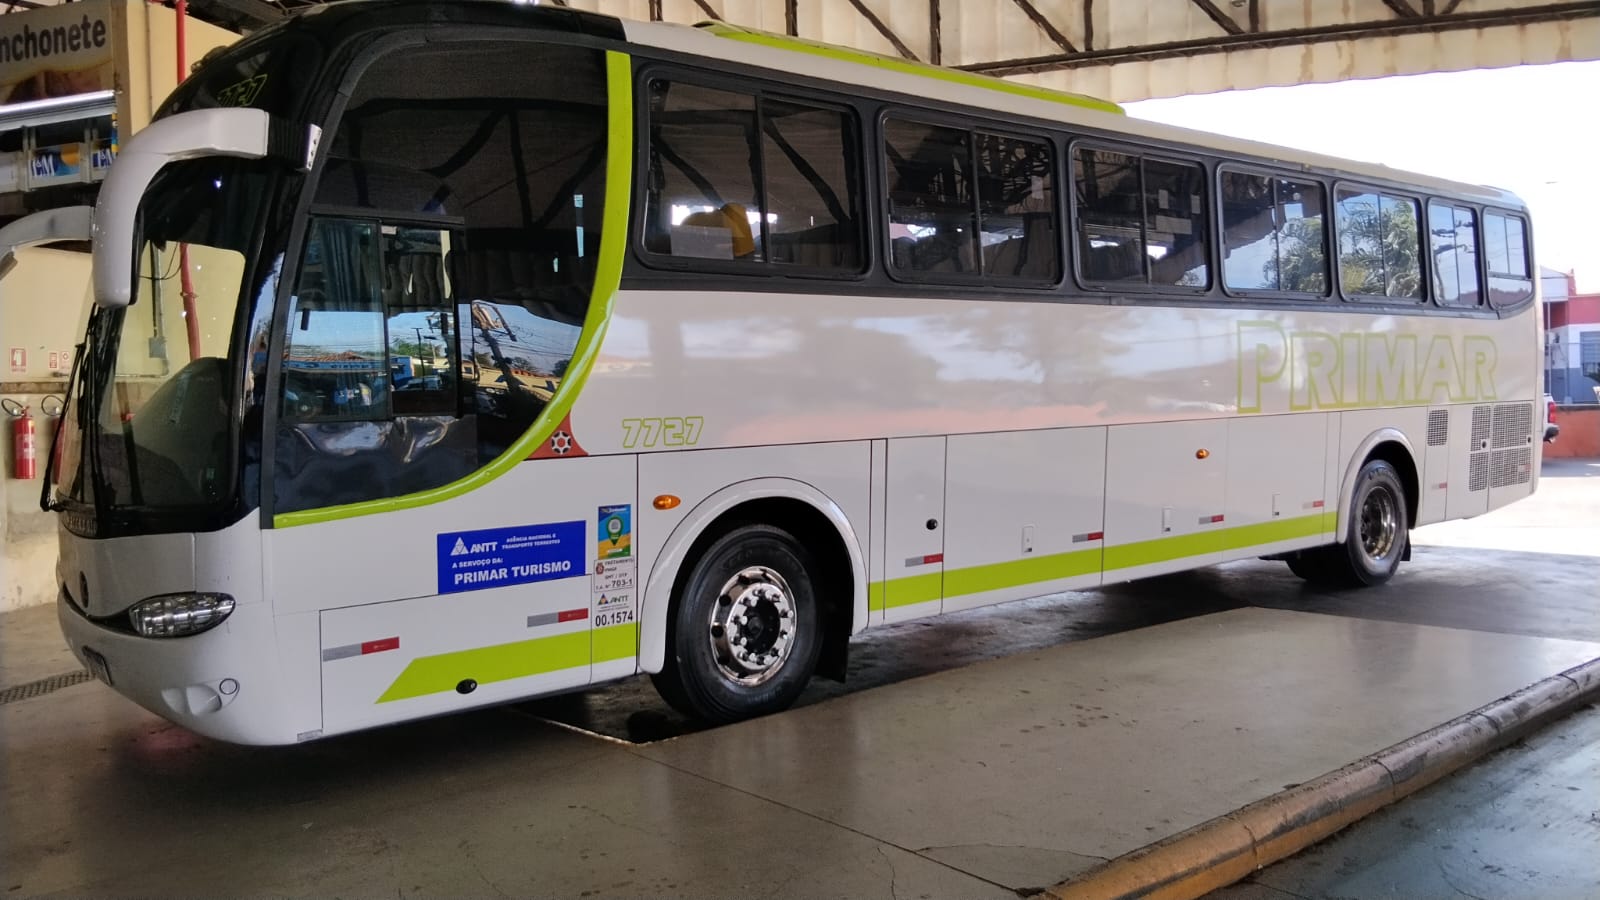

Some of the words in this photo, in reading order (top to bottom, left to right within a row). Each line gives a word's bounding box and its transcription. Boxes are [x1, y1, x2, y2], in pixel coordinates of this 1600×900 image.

[1237, 320, 1497, 414] PRIMAR
[622, 416, 704, 448] 7727
[470, 541, 498, 554] ANTT
[454, 567, 508, 585] PRIMAR
[511, 560, 572, 577] TURISMO
[611, 578, 632, 587] 703-1
[595, 608, 633, 627] 00.1574
